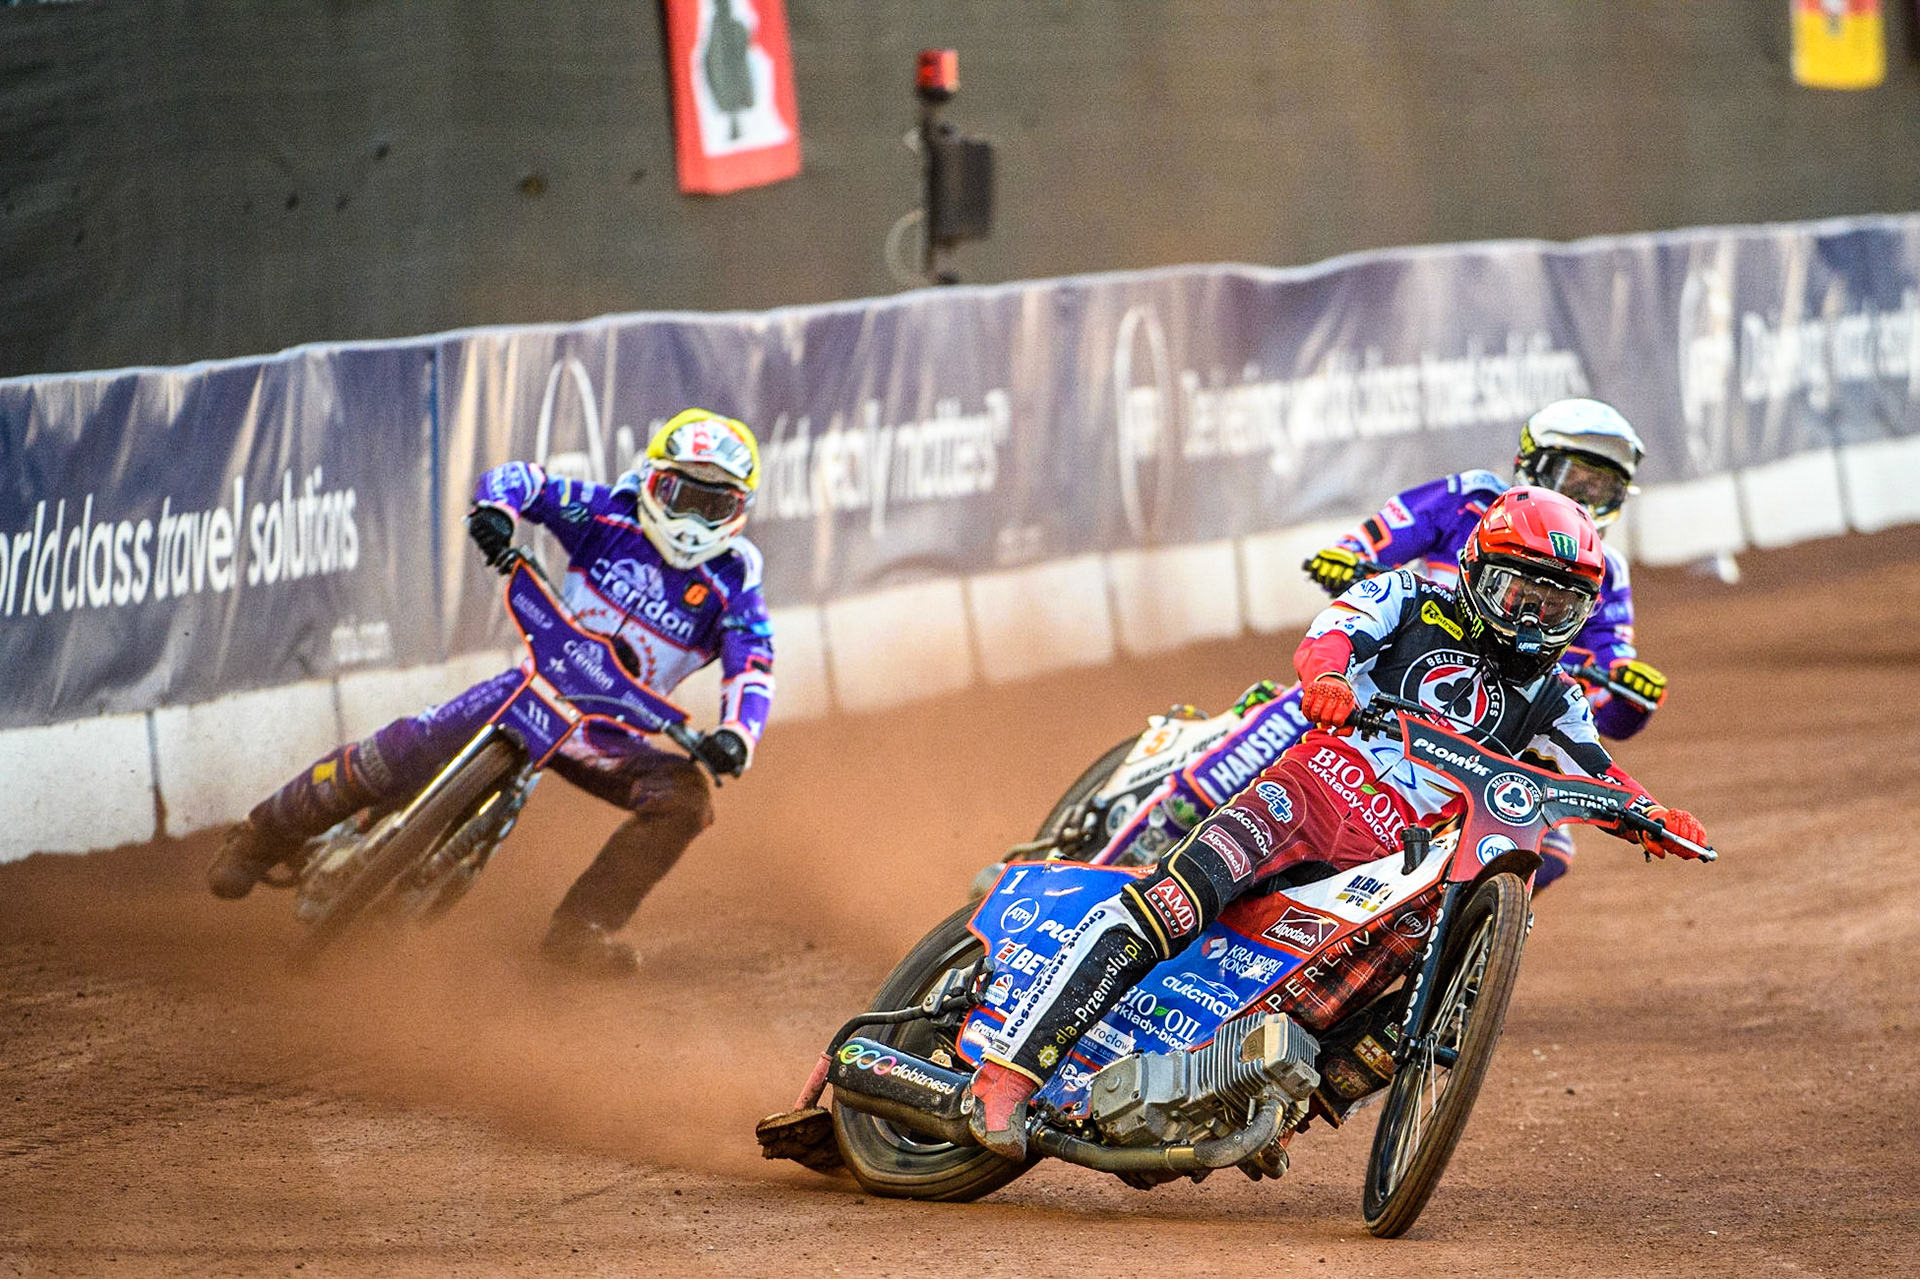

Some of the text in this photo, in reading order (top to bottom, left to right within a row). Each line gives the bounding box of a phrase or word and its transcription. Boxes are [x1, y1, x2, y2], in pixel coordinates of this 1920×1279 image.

[62, 492, 152, 610] class
[154, 475, 244, 601] travel
[248, 465, 359, 588] solutions
[1426, 653, 1464, 667] BELLE
[1486, 685, 1500, 718] ACES
[1208, 712, 1299, 795] HANSEN
[1310, 746, 1406, 847] BIO OIL
[1204, 832, 1242, 874] Alpodach
[1000, 869, 1029, 894] 1
[1007, 906, 1031, 925] ATPI
[1156, 884, 1195, 931] AMD
[1271, 922, 1317, 948] Alpodach
[1164, 1008, 1202, 1043] OIL
